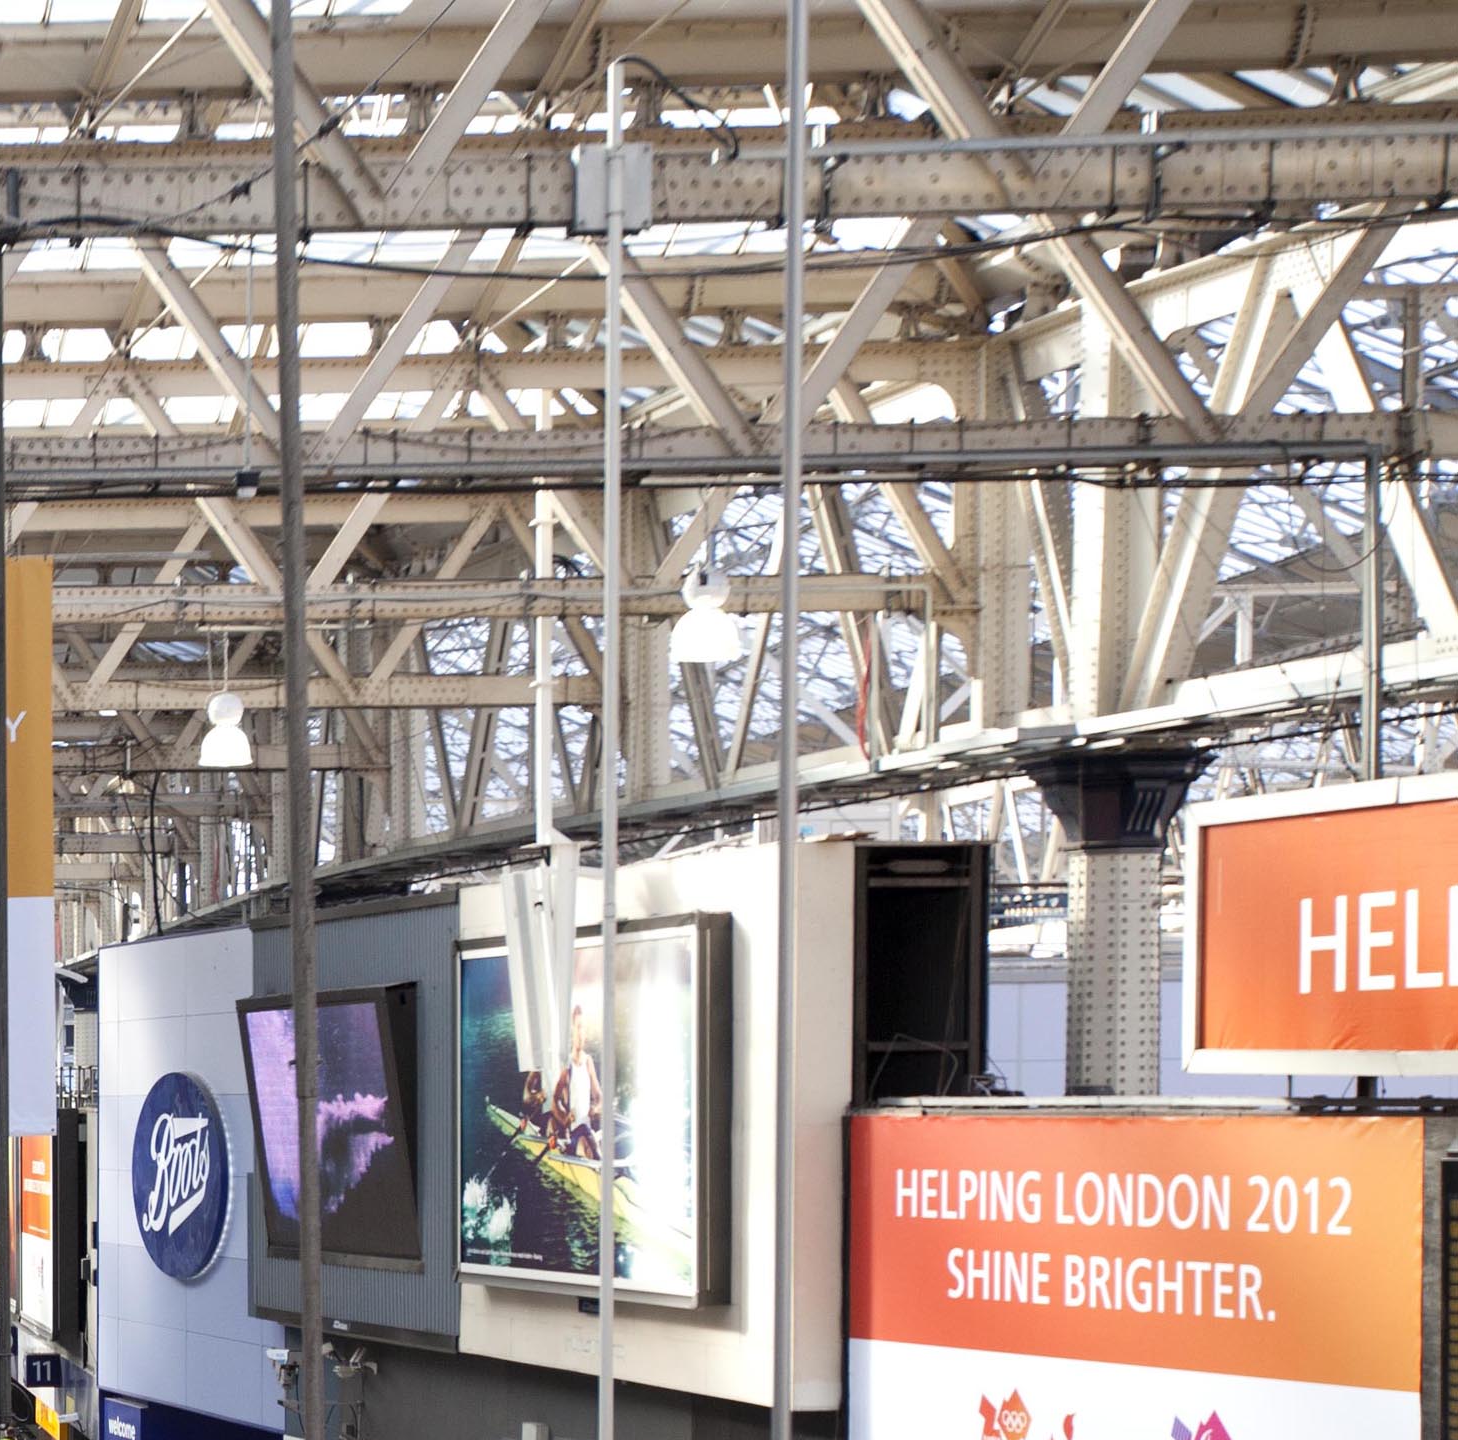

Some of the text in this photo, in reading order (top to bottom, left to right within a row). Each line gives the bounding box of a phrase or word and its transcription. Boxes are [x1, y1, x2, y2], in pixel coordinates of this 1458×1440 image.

[142, 1112, 210, 1236] Boots
[894, 1167, 1353, 1236] HELPING LONDON 2012
[946, 1246, 1277, 1322] SHINE BRIGHTER.
[32, 1360, 51, 1382] 11
[108, 1416, 136, 1440] welcome
